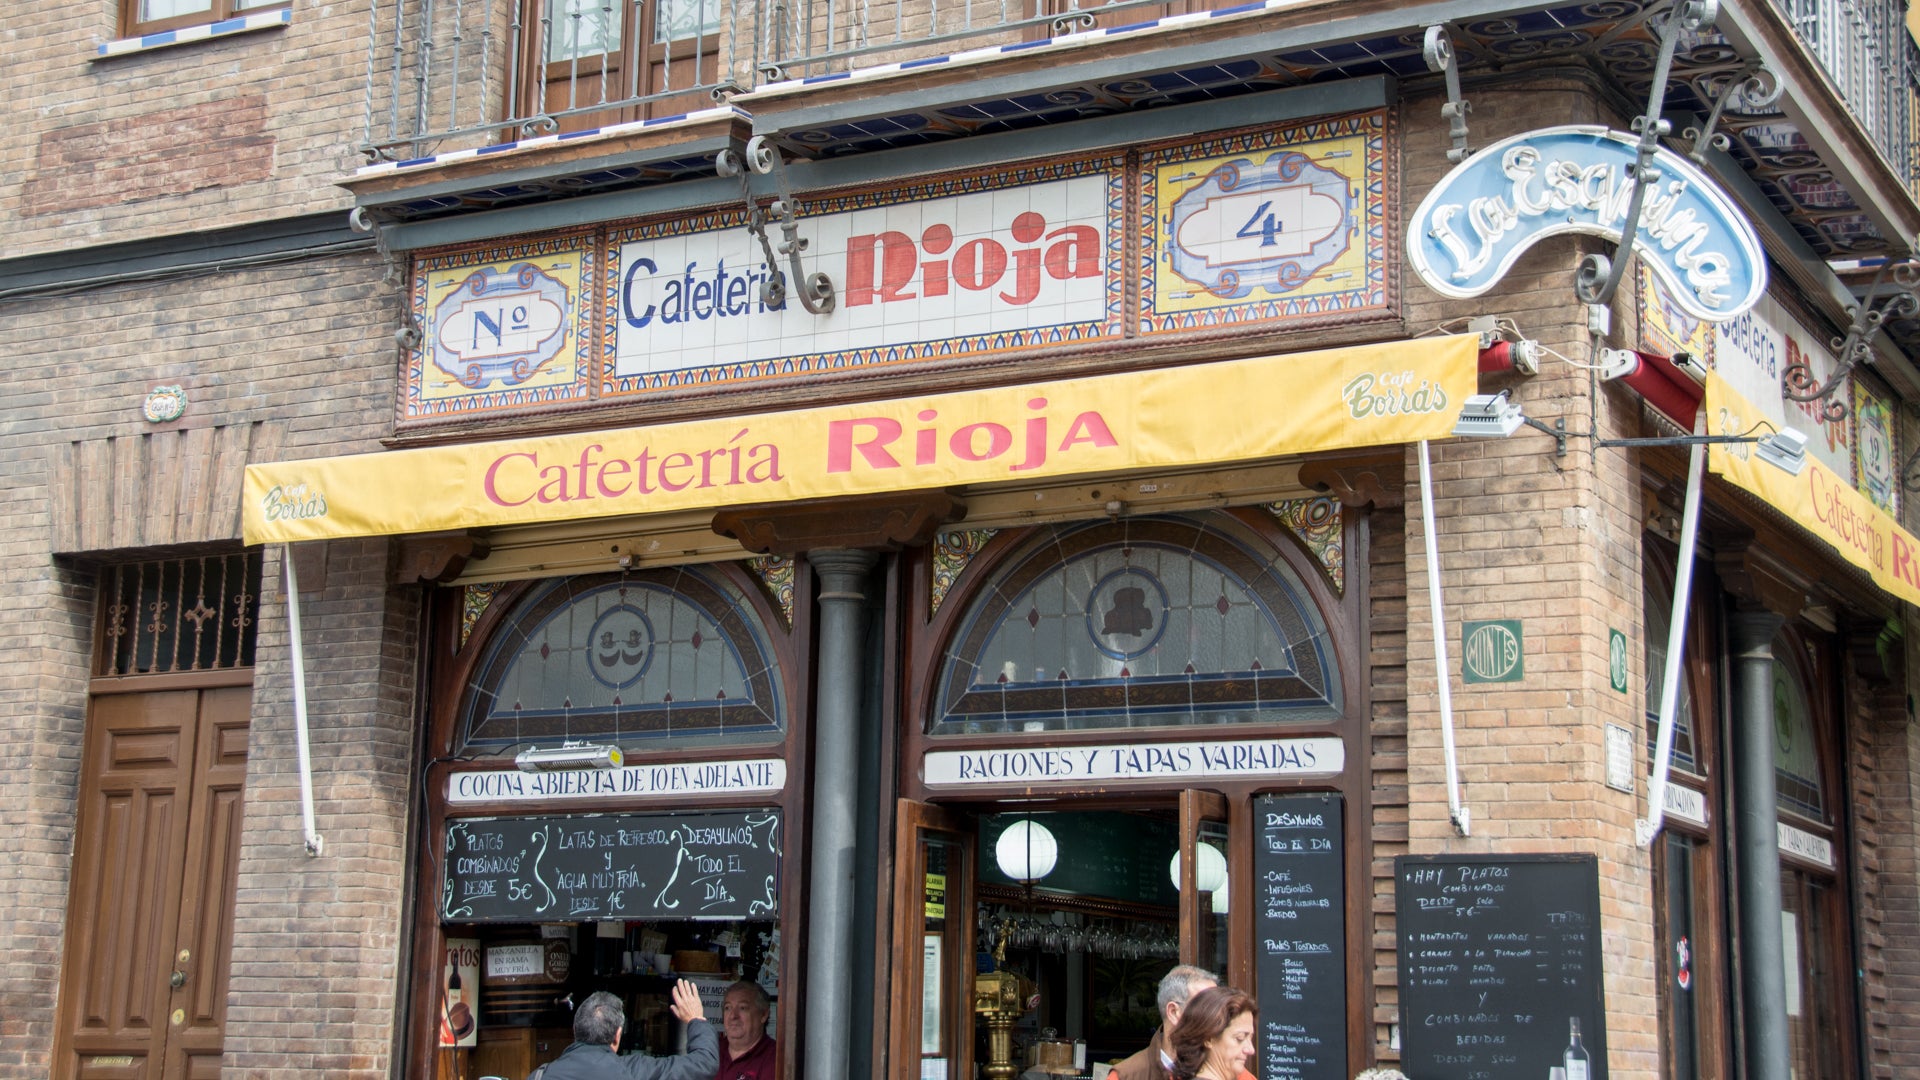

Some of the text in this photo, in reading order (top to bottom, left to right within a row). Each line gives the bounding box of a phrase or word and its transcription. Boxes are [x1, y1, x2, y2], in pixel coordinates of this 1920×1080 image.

[1236, 200, 1284, 247] 4
[1431, 146, 1732, 308] La Esquina
[845, 211, 1105, 308] Rioja
[1379, 369, 1415, 388] Café
[1342, 372, 1448, 419] Borrás
[484, 428, 784, 508] Cafetería
[1810, 466, 1884, 571] Cafetería
[959, 742, 1317, 779] RACIONES Y TAPAS VARIADAS
[459, 762, 774, 797] COCINA ABIERTA DE 10 EN ADELANTE
[467, 833, 504, 851] PLATOS
[559, 830, 596, 850] LATAS
[600, 834, 615, 847] DE
[685, 826, 752, 845] DESAYUNOS
[694, 855, 746, 873] TODO EL
[557, 873, 588, 890] AGUA
[592, 872, 615, 889] MUY
[1457, 866, 1510, 882] PLATOS
[463, 879, 532, 900] DESDE 5€
[1442, 884, 1505, 893] COMBINADOS
[1416, 897, 1456, 907] DESDE
[488, 946, 539, 956] MANZANILLA
[505, 956, 529, 964] RAMA
[1424, 1013, 1534, 1026] COMBINADOS DE
[1456, 1035, 1505, 1046] BEBIDAS
